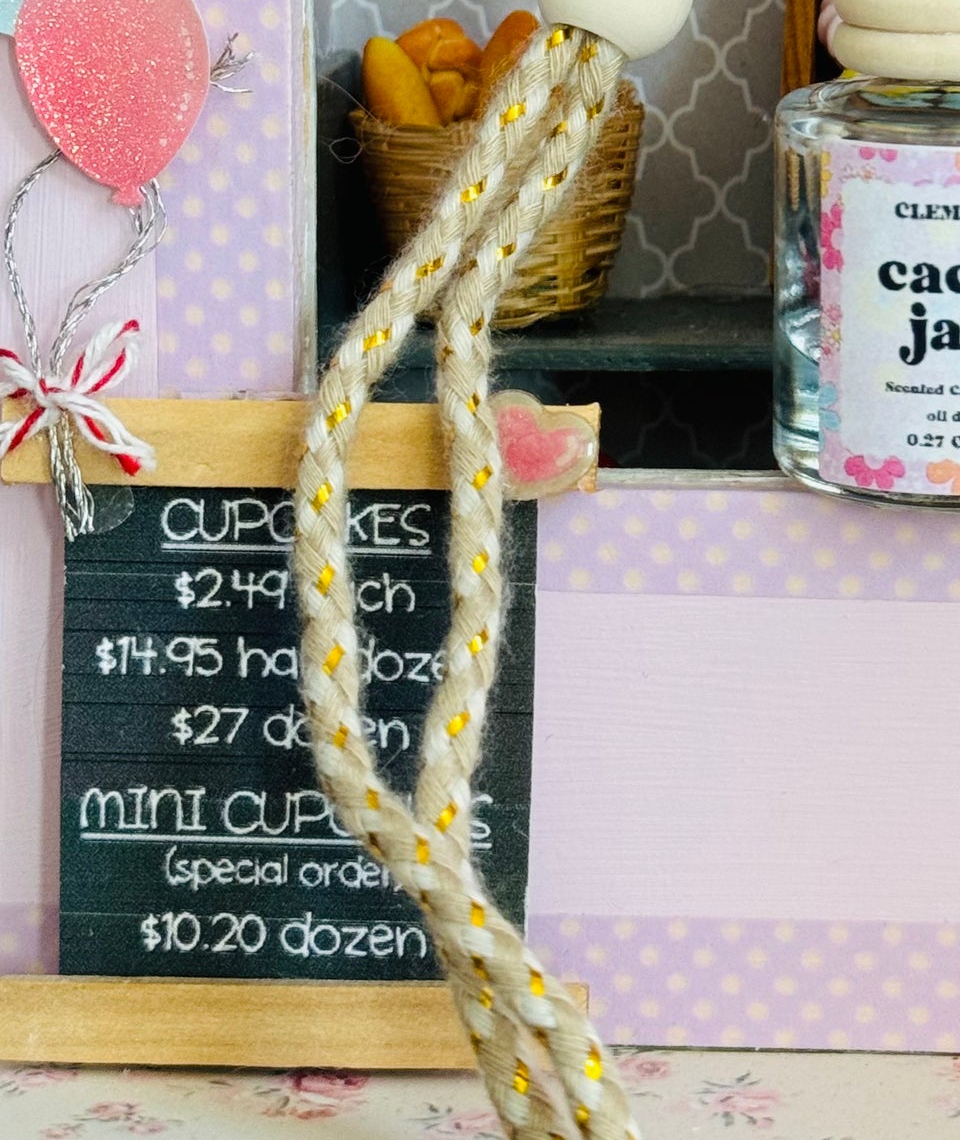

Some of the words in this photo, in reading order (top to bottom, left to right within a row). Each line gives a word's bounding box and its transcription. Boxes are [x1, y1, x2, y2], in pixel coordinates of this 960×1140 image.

[885, 380, 945, 396] Scented
[906, 432, 945, 448] 0.27
[926, 410, 948, 422] oil
[161, 497, 432, 547] CUPCKES
[174, 568, 289, 610] $2.49
[95, 635, 224, 677] $14.95
[236, 635, 300, 680] ha
[357, 637, 446, 684] doze
[171, 704, 250, 746] $27
[262, 703, 411, 751] doen
[164, 844, 289, 892] (special
[140, 911, 267, 953] $10.20
[279, 910, 428, 959] dozen
